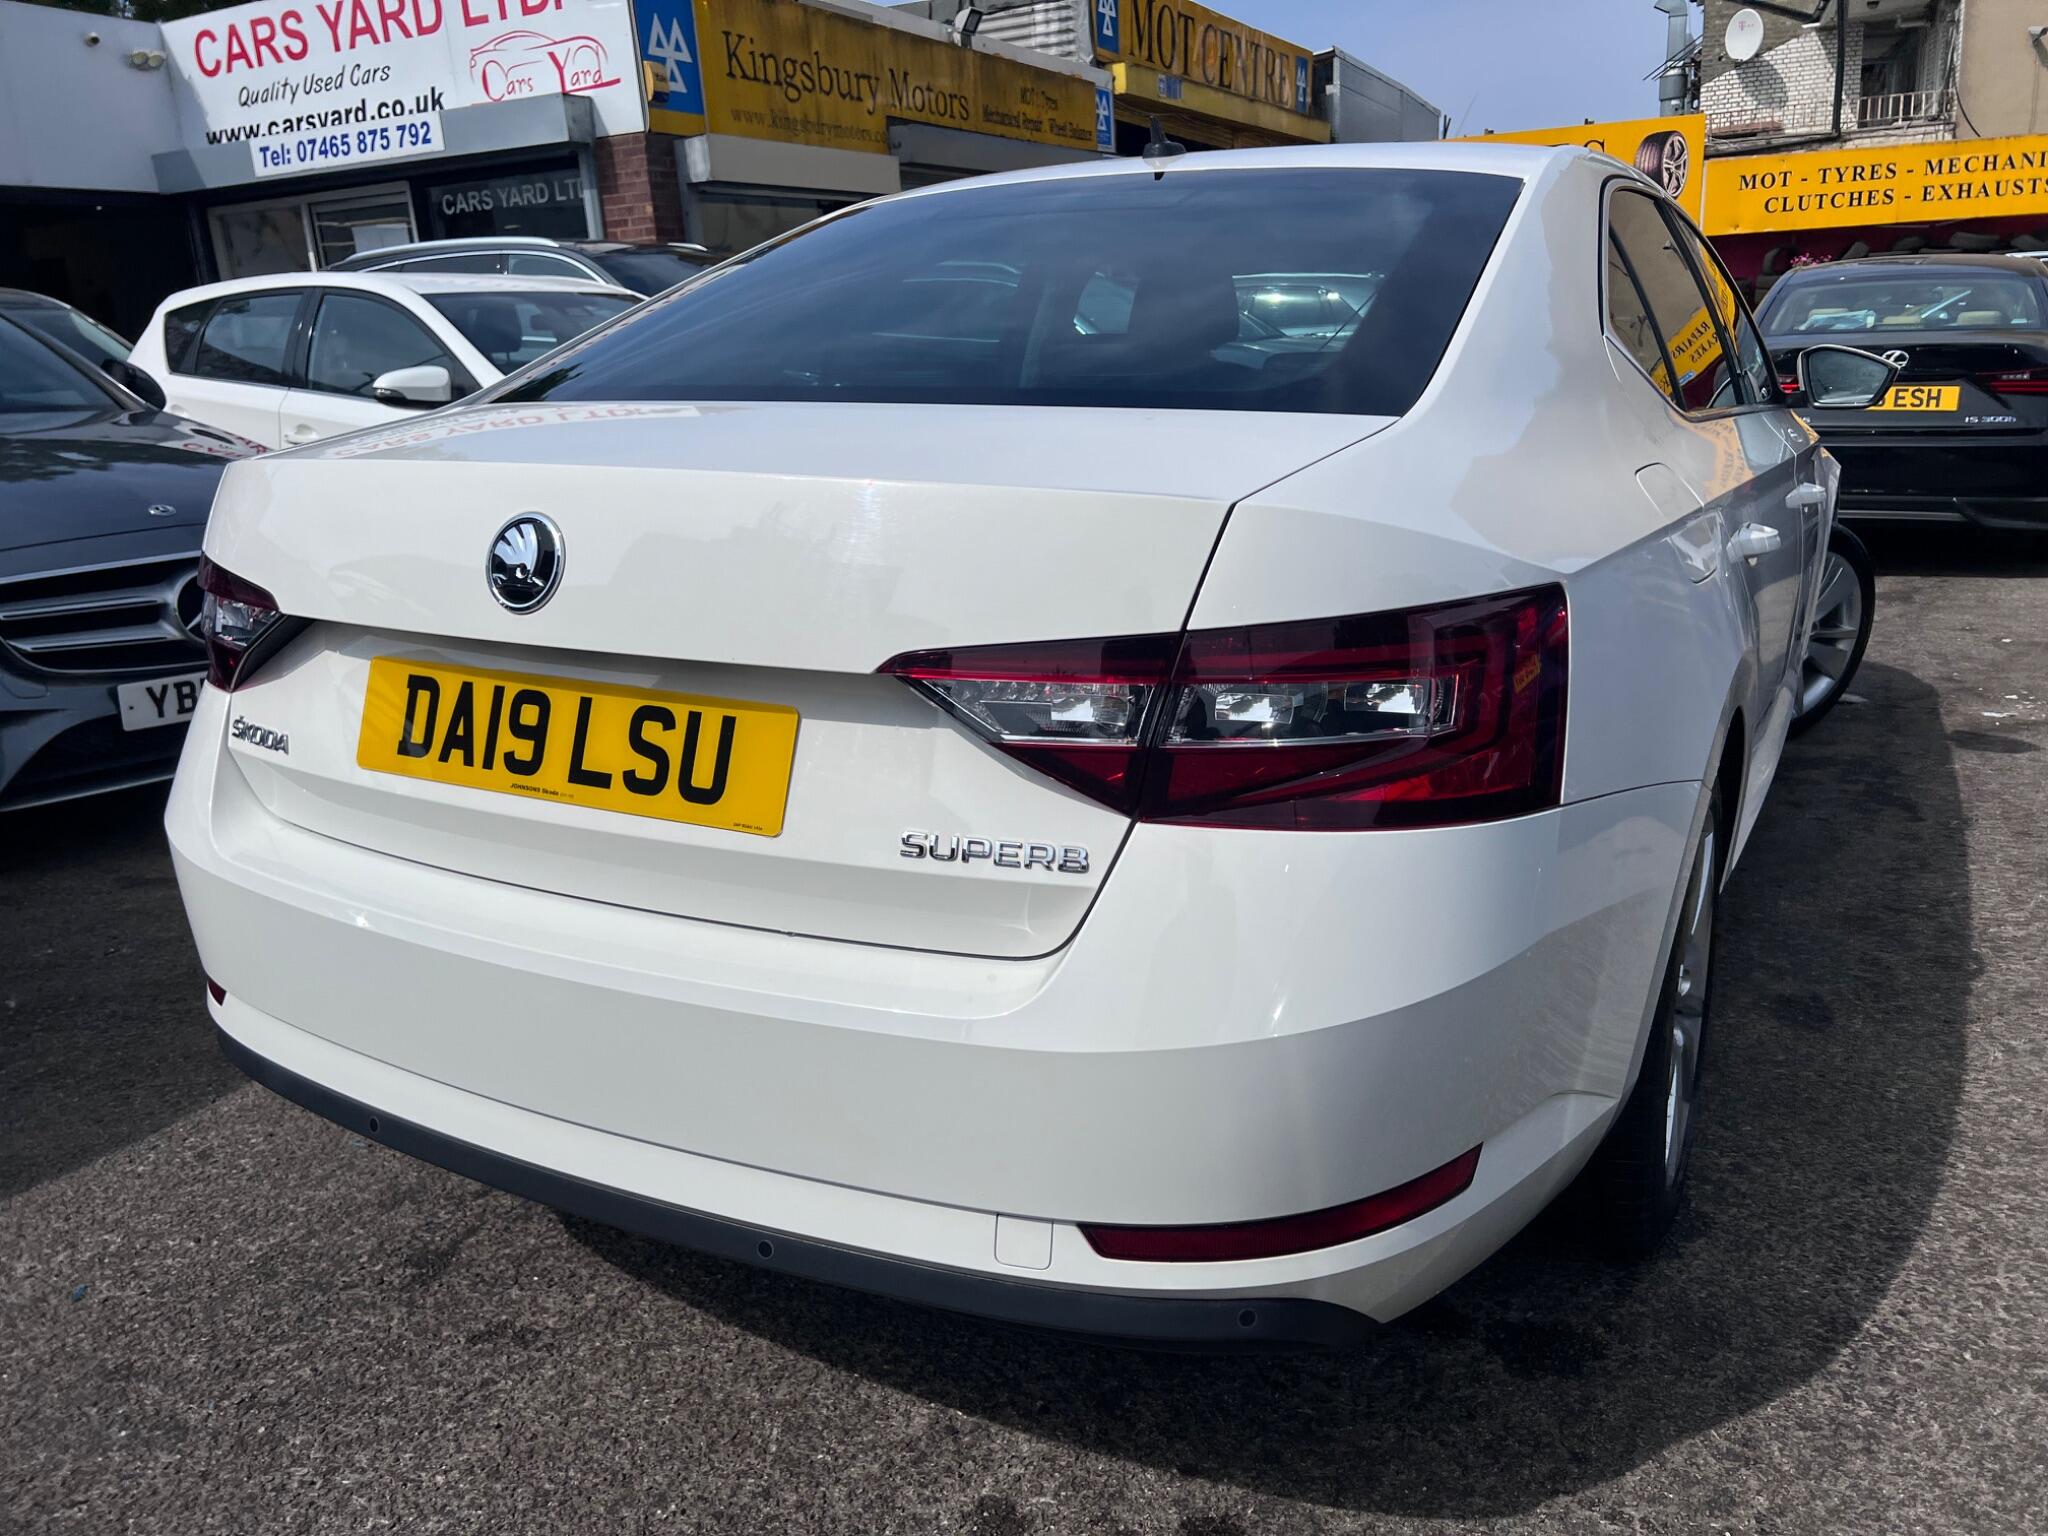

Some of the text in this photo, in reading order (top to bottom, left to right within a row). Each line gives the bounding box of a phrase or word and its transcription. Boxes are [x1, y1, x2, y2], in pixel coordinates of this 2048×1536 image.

[194, 9, 309, 78] CARS
[315, 0, 442, 52] YARD
[1129, 0, 1291, 106] MOT CENTRE
[238, 63, 391, 107] Quality Used Cars
[482, 45, 606, 101] Cars Yard
[722, 30, 970, 121] Kingsbury Motors
[259, 120, 432, 169] Tel: 07465 875 792
[1739, 170, 1793, 192] MOT
[1818, 162, 1898, 185] TYRES
[1924, 151, 2048, 176] MECHANI
[442, 190, 494, 216] CARS
[496, 182, 549, 209] YARD
[1764, 188, 1895, 214] CLUTCHES
[1893, 388, 1942, 408] ESH
[145, 677, 206, 719] YB
[232, 716, 290, 755] ŠKODA
[397, 673, 737, 806] DA19 LSU
[900, 829, 1090, 873] SUPERB
